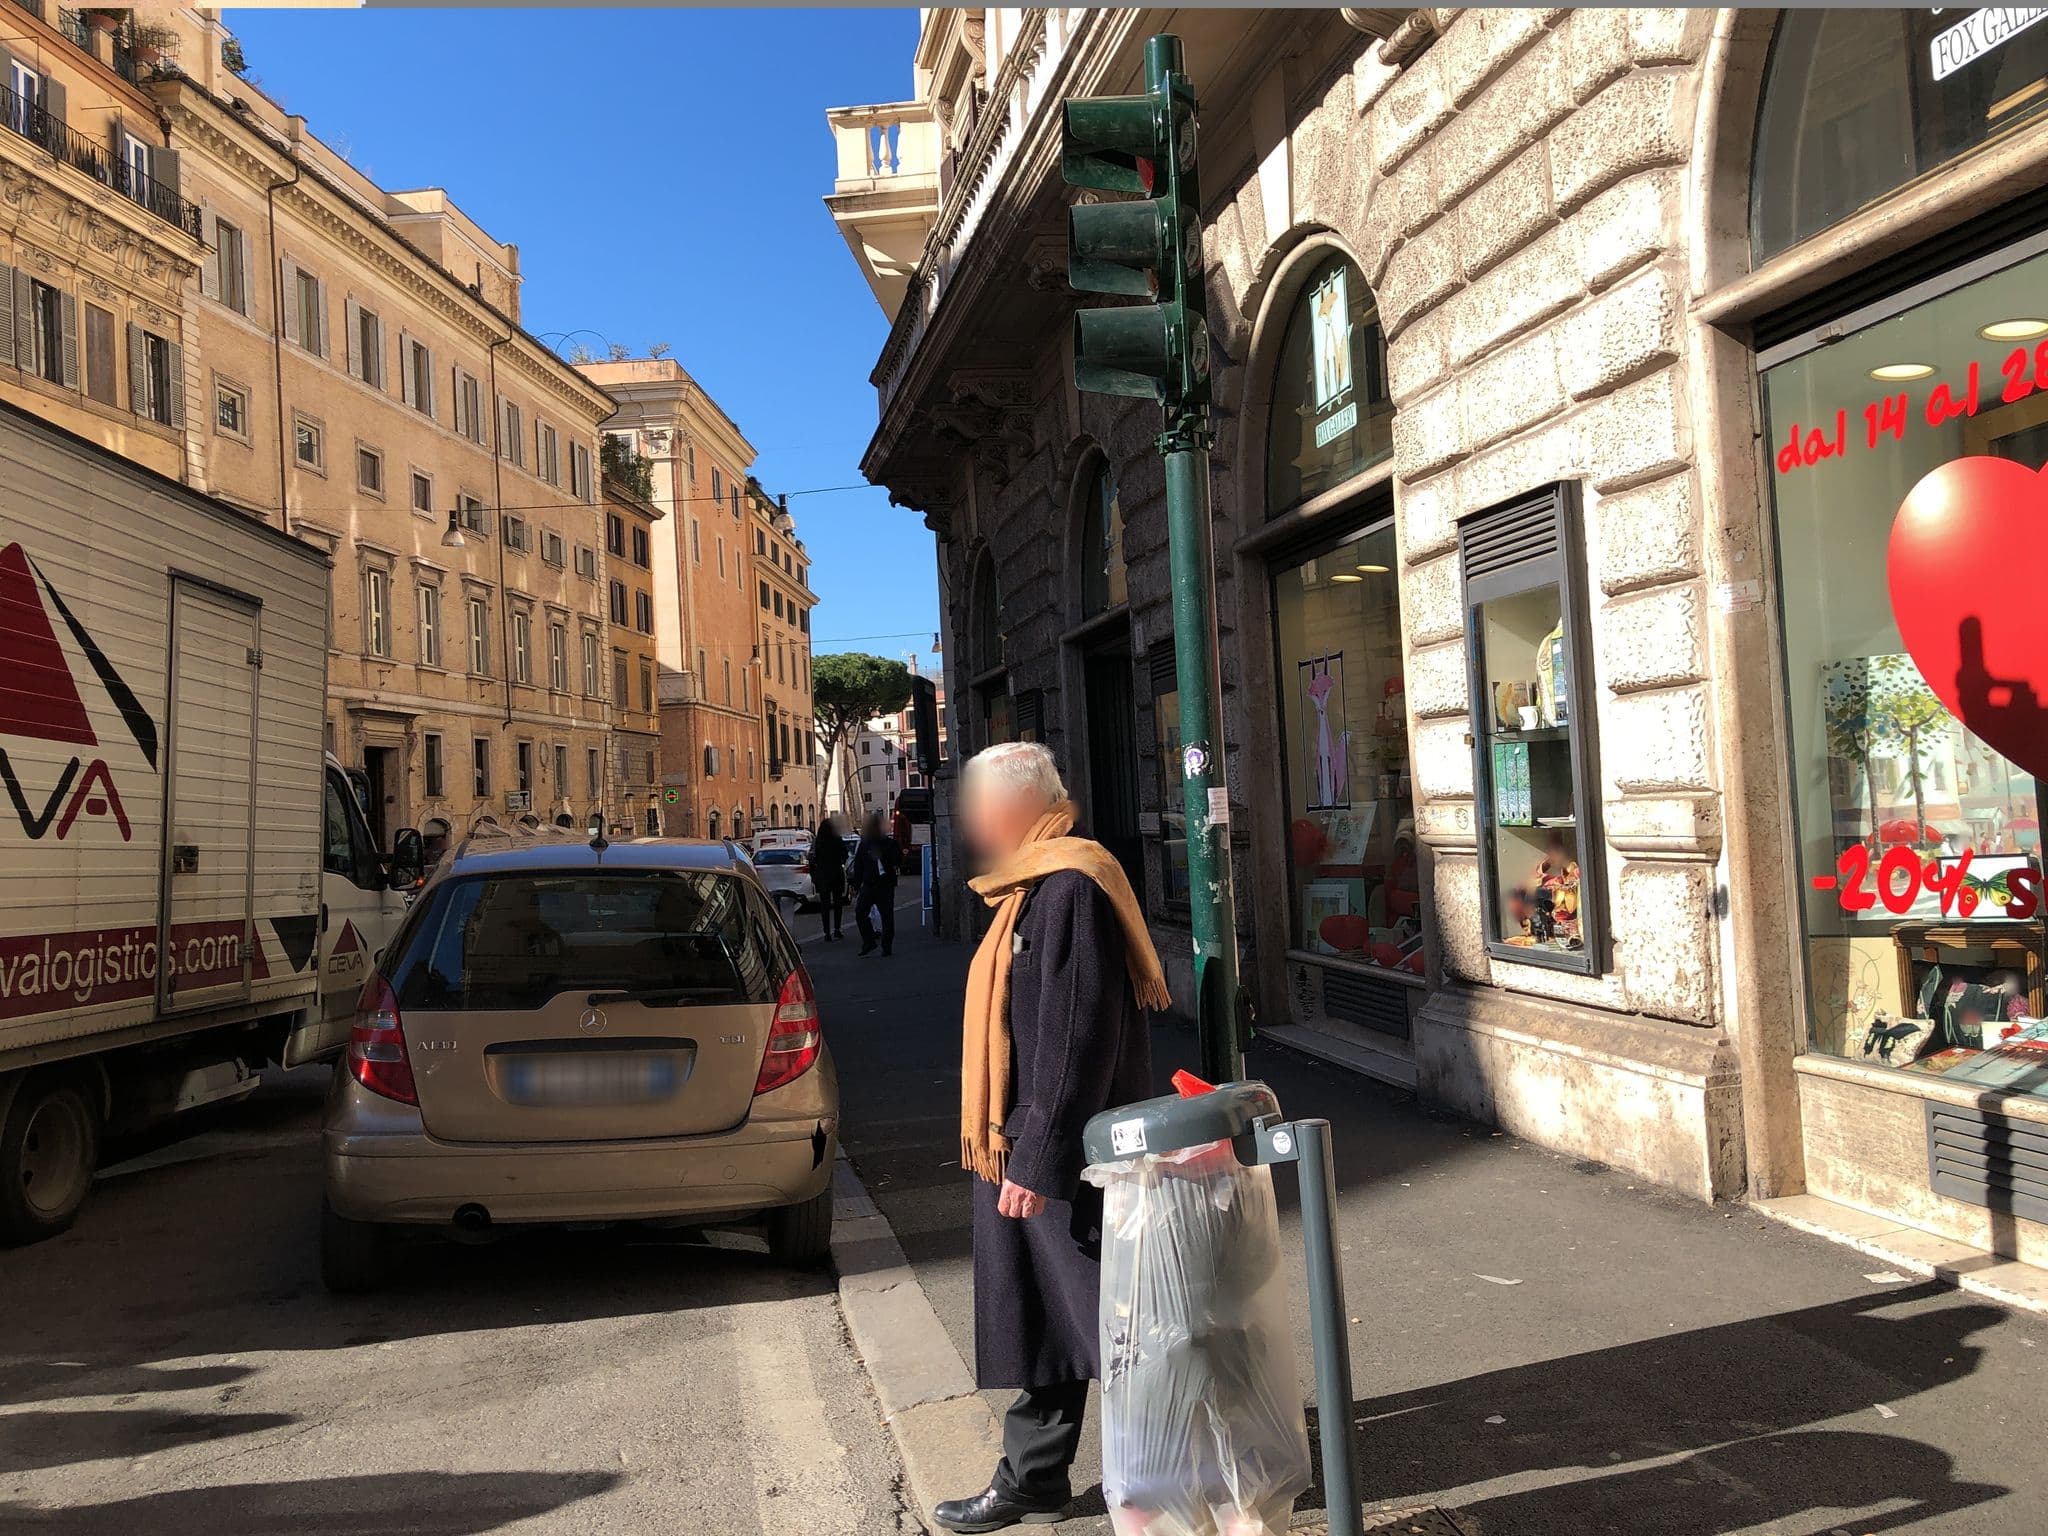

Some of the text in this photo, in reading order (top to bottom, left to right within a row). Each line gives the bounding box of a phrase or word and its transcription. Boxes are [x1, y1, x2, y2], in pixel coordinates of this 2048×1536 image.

[1938, 18, 1980, 74] FOX
[1777, 408, 1847, 474] dal
[1863, 392, 1909, 449] 14
[1925, 361, 1980, 427] al
[1812, 844, 1978, 918] -20%
